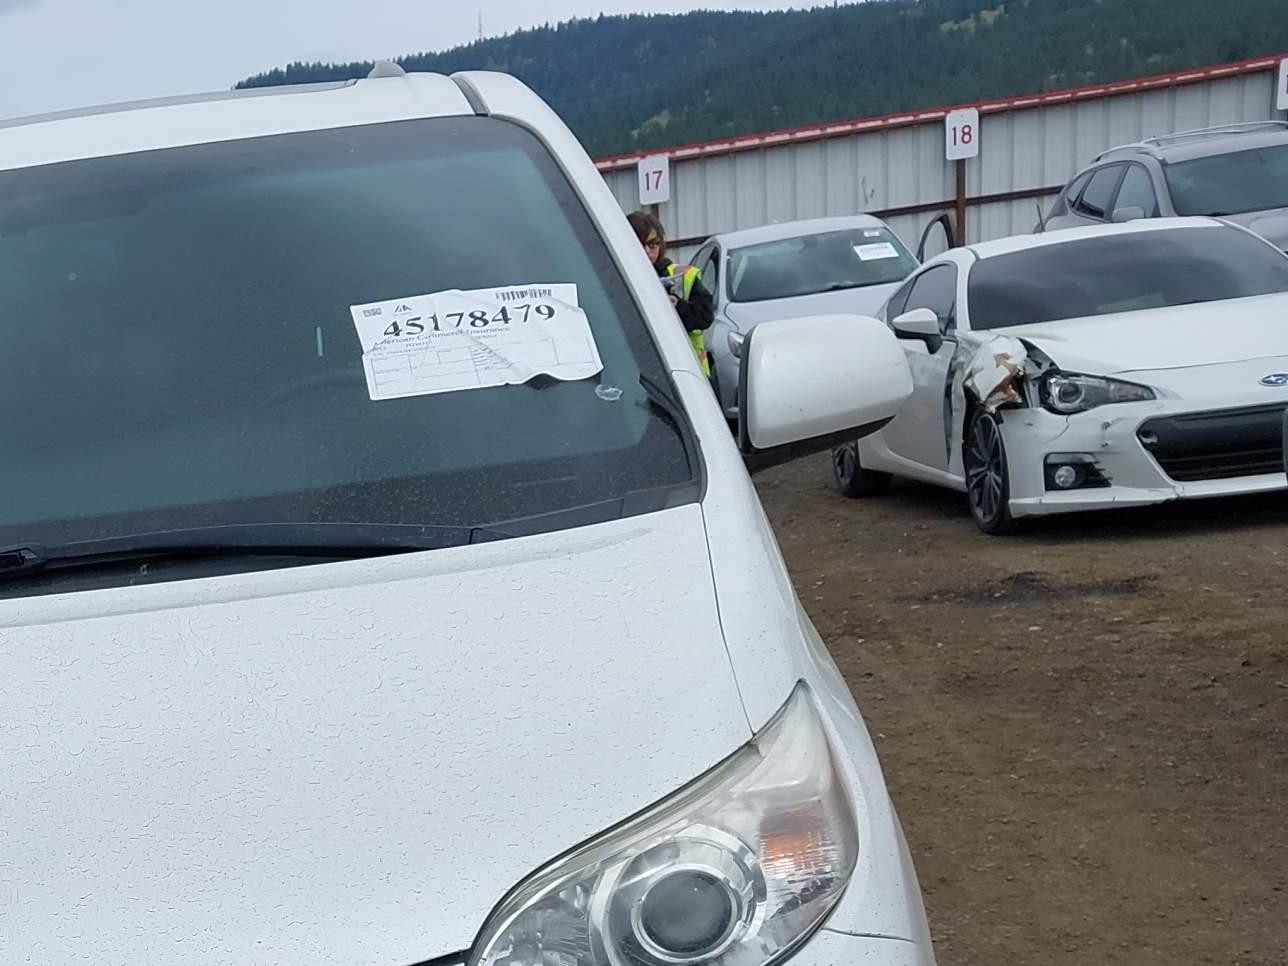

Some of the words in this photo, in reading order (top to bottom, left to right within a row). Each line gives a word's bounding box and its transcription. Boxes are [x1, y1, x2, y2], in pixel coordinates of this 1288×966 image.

[952, 124, 972, 146] 18
[645, 170, 663, 191] 17
[383, 303, 556, 337] 45178479
